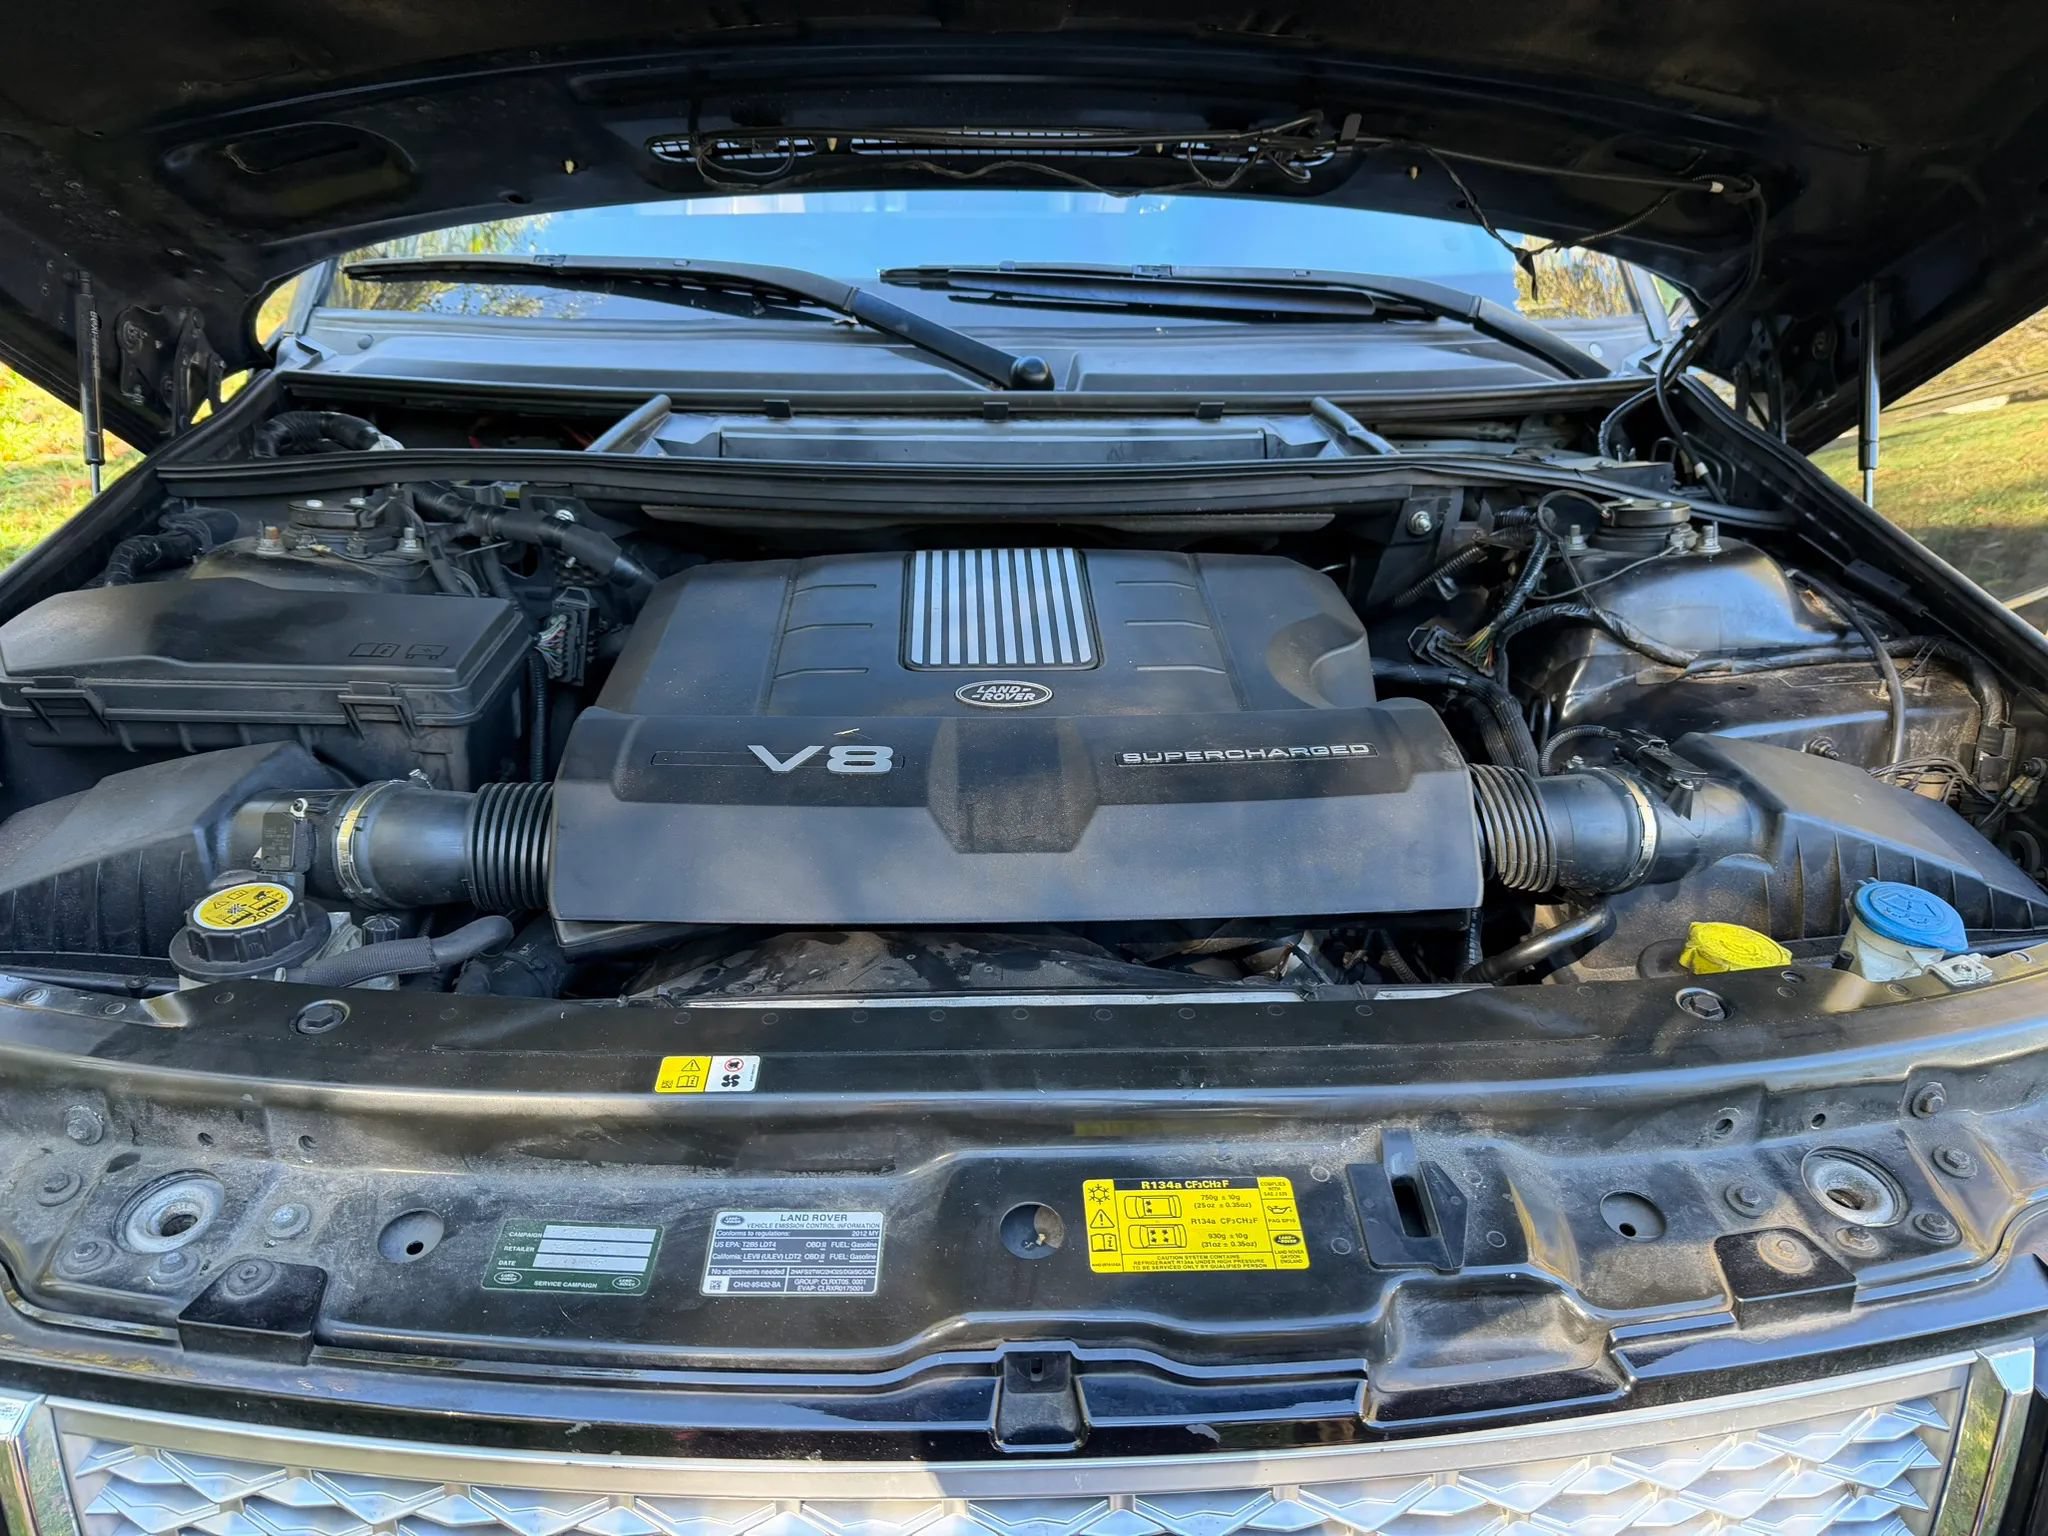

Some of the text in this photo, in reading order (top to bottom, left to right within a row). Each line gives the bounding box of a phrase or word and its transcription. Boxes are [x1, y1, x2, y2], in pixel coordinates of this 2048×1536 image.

[747, 744, 894, 773] V8
[1122, 744, 1370, 764] SUPERCHARGED
[1141, 1180, 1182, 1190] R134a
[850, 1253, 876, 1261] Gasoline
